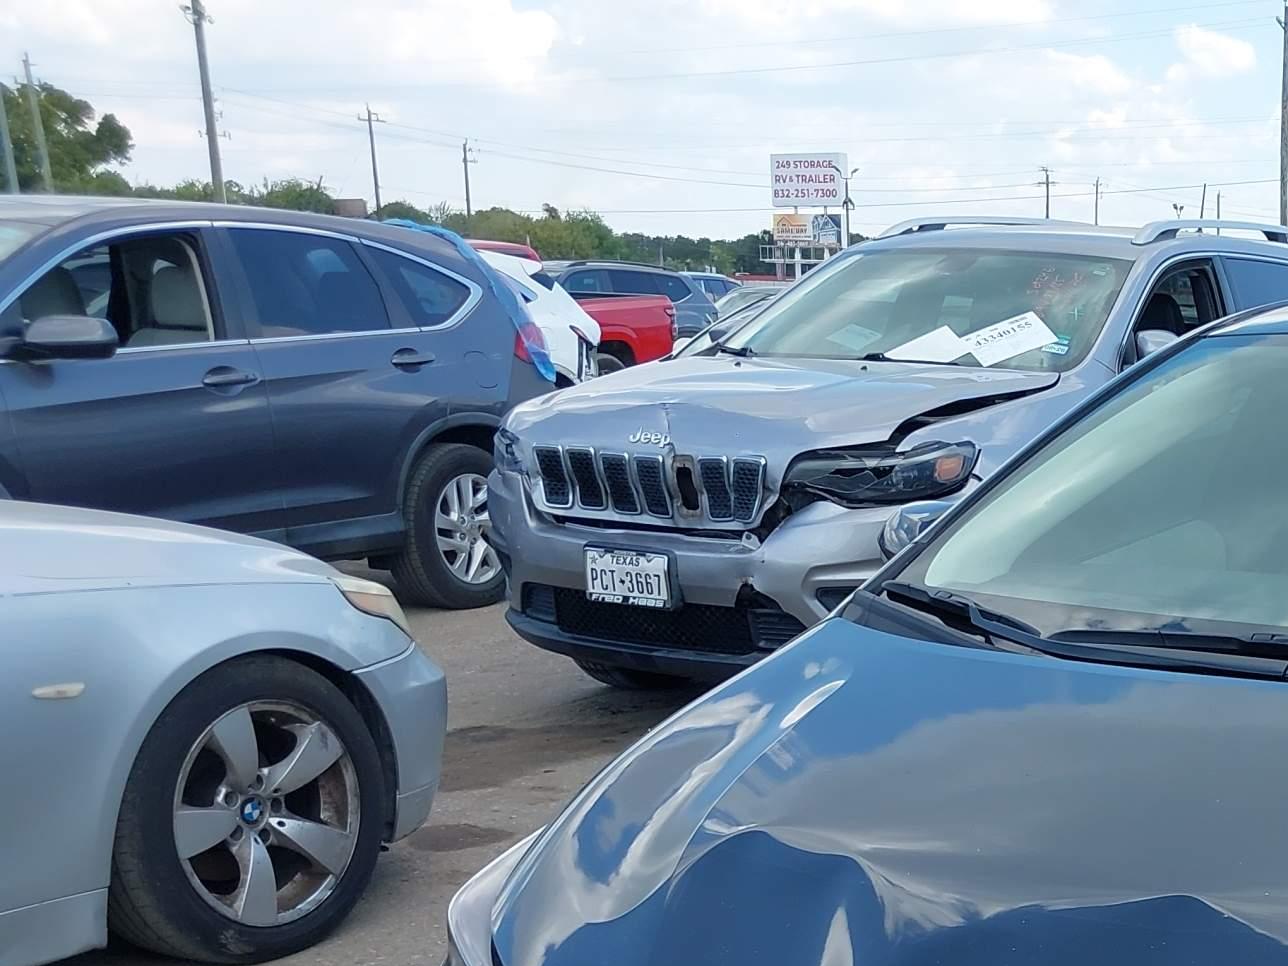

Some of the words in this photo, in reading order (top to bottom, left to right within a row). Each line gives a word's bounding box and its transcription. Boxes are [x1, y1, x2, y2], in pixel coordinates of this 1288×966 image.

[775, 160, 791, 169] 249
[793, 160, 833, 169] STORAGE
[775, 174, 789, 184] RV
[795, 174, 836, 184] TRAILER
[774, 188, 838, 198] 832-251-7300
[974, 321, 1033, 347] 43340155
[629, 426, 671, 448] Jeep
[610, 554, 641, 567] TEXAS
